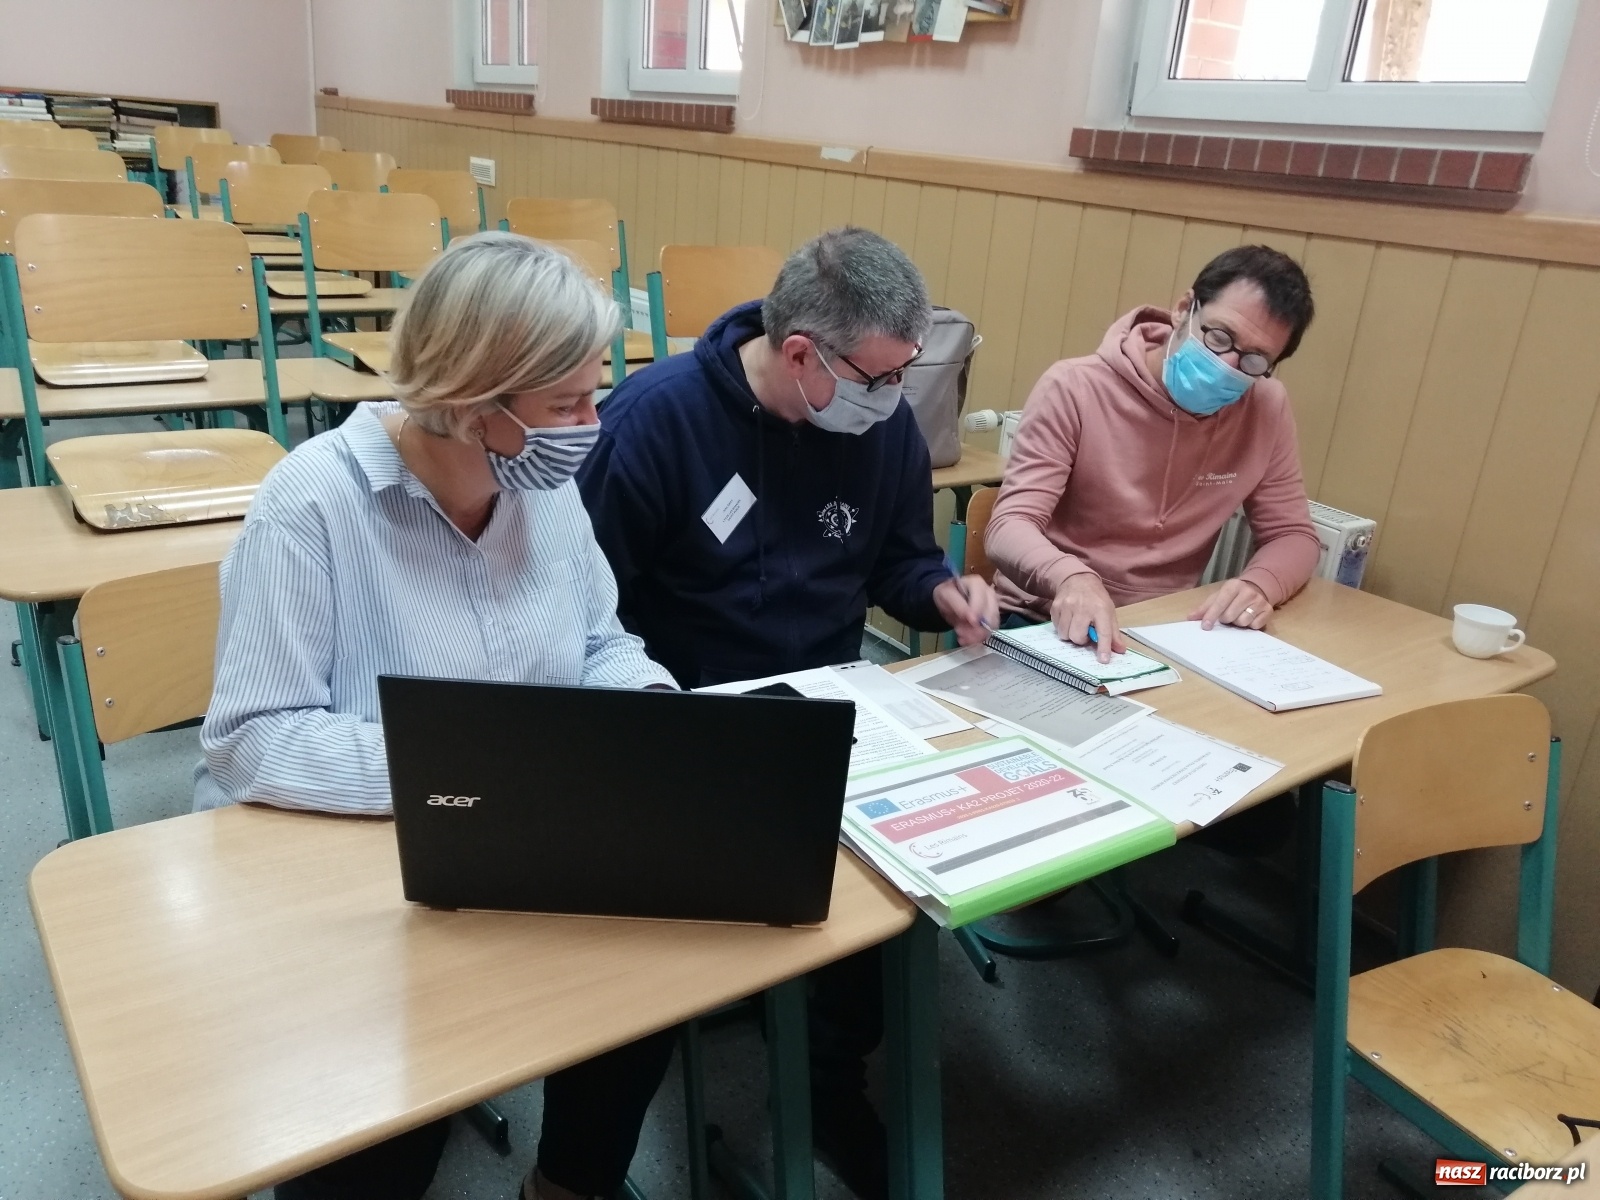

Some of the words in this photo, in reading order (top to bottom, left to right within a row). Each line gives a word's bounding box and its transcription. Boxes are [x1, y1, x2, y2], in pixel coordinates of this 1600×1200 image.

[987, 751, 1039, 769] SUSTAINABLE
[1003, 760, 1058, 781] GOALS
[426, 794, 481, 807] acer
[890, 808, 956, 831] ERASMUS+
[956, 799, 982, 811] KA2
[980, 786, 1025, 804] PROJET
[1023, 774, 1065, 790] 2020-22
[899, 785, 967, 809] Erasmus+
[923, 842, 940, 850] Les
